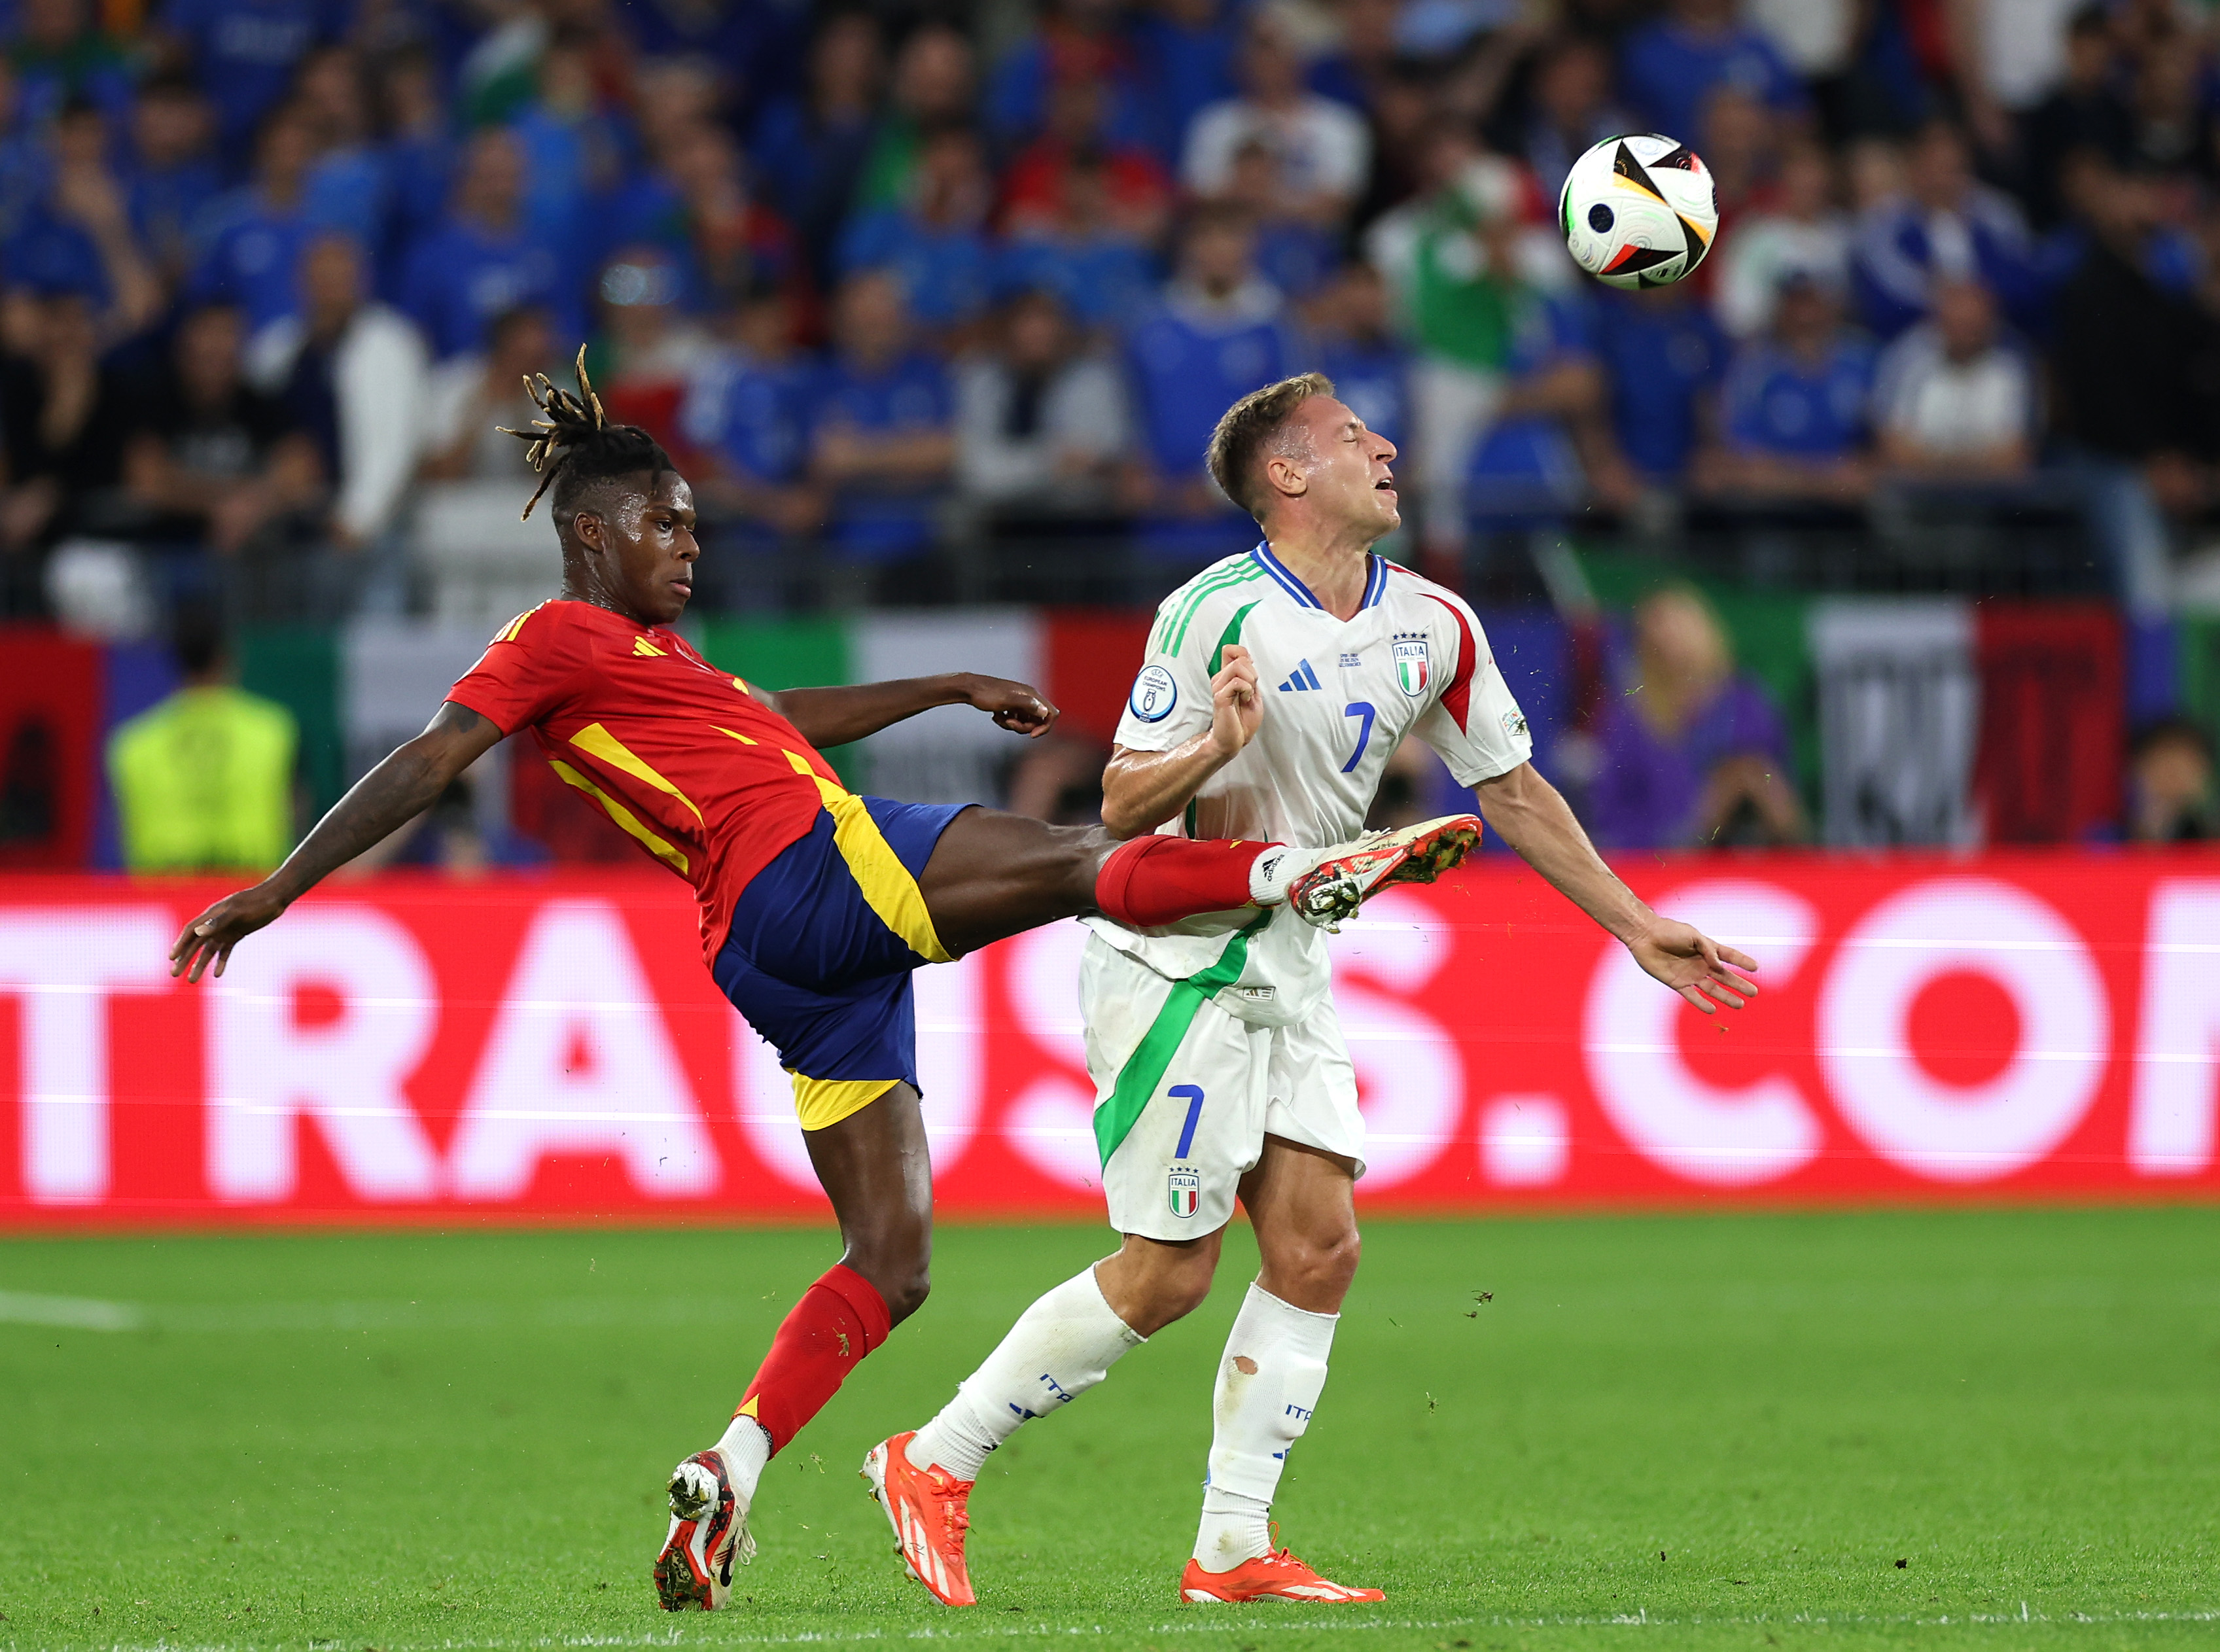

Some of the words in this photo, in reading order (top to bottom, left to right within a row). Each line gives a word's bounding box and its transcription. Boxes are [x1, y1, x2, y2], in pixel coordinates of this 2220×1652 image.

[1395, 646, 1425, 657] ITALIA
[1142, 681, 1167, 692] CHAMPIONS
[1144, 675, 1168, 686] EUROPEAN
[1341, 701, 1375, 772] 7
[1267, 854, 1285, 882] adidas
[1168, 1084, 1205, 1159] 7
[1171, 1178, 1197, 1186] ITALIA
[759, 1424, 773, 1452] adida
